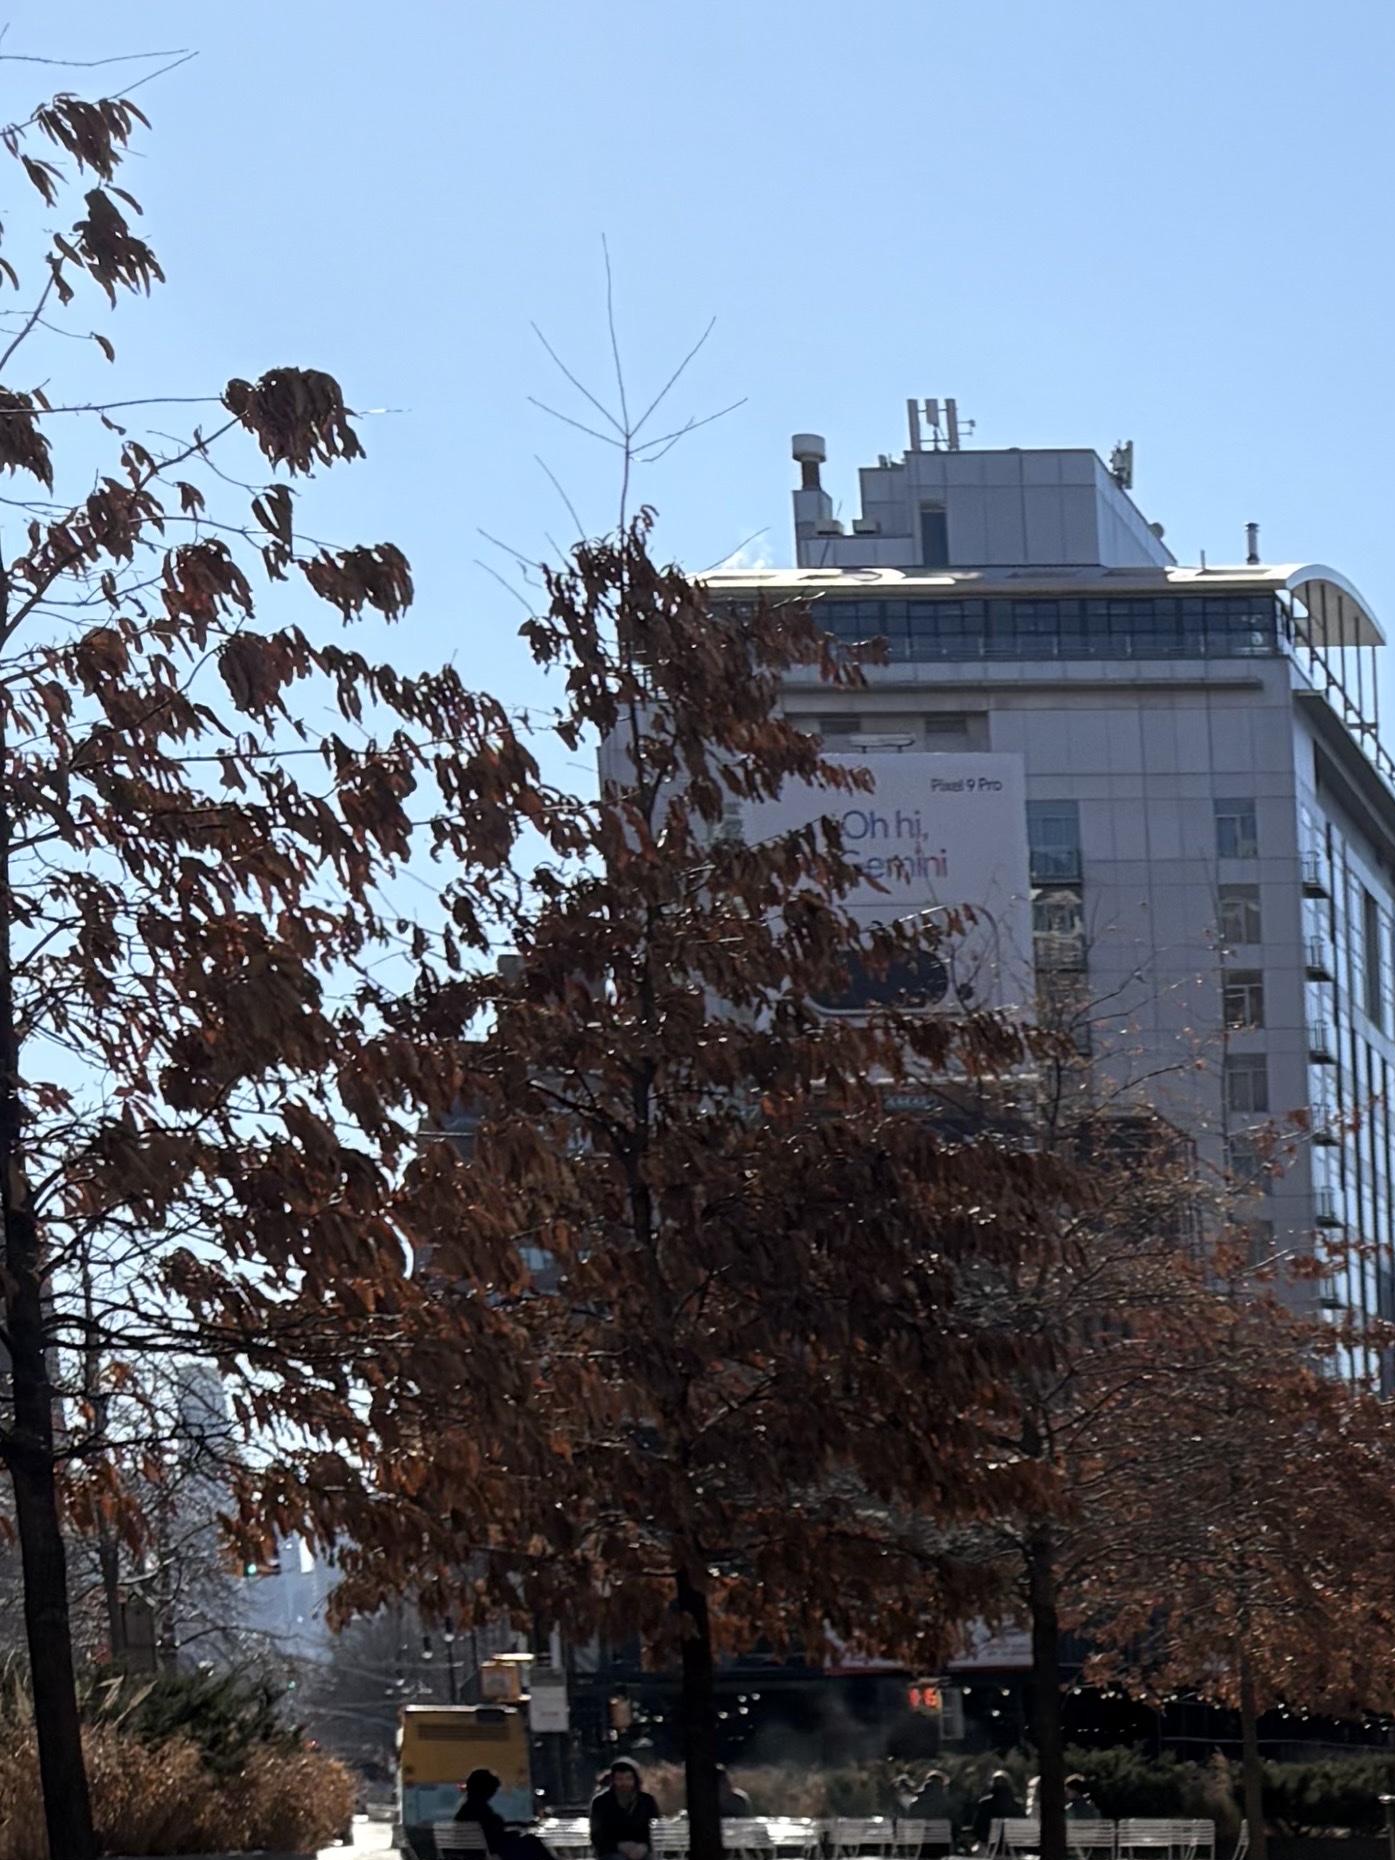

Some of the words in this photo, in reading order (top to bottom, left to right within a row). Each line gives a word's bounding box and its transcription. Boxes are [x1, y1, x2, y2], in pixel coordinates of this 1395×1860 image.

[966, 778, 975, 792] 9
[978, 777, 1003, 792] Pro
[841, 810, 889, 839] Oh
[895, 810, 928, 841] hi,
